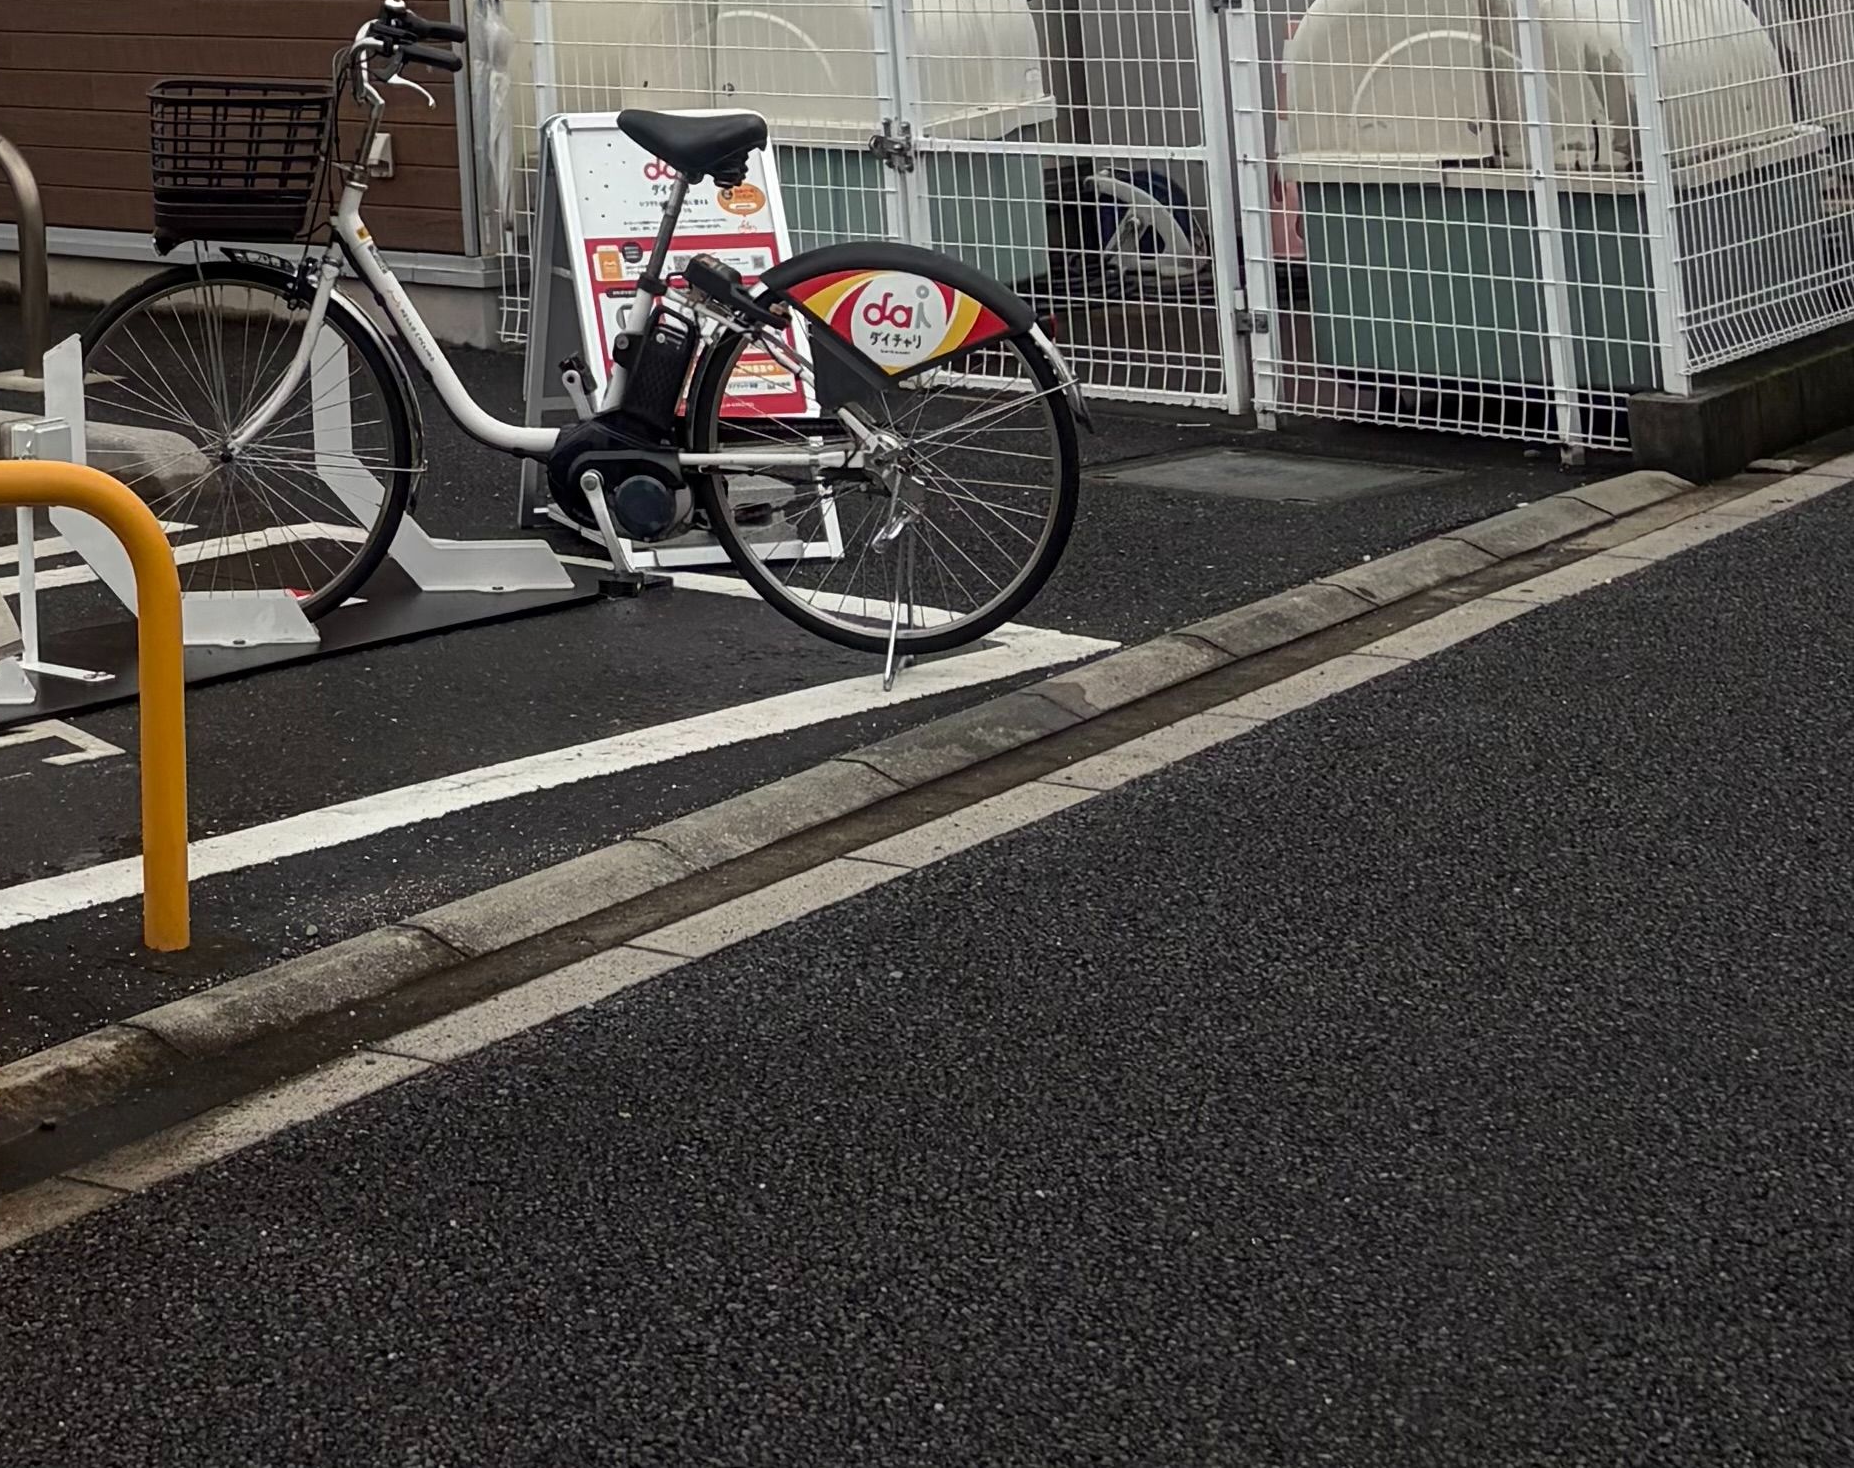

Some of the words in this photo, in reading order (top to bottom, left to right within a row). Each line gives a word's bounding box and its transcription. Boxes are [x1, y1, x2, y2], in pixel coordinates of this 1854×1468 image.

[869, 331, 922, 349] ダイチャリ
